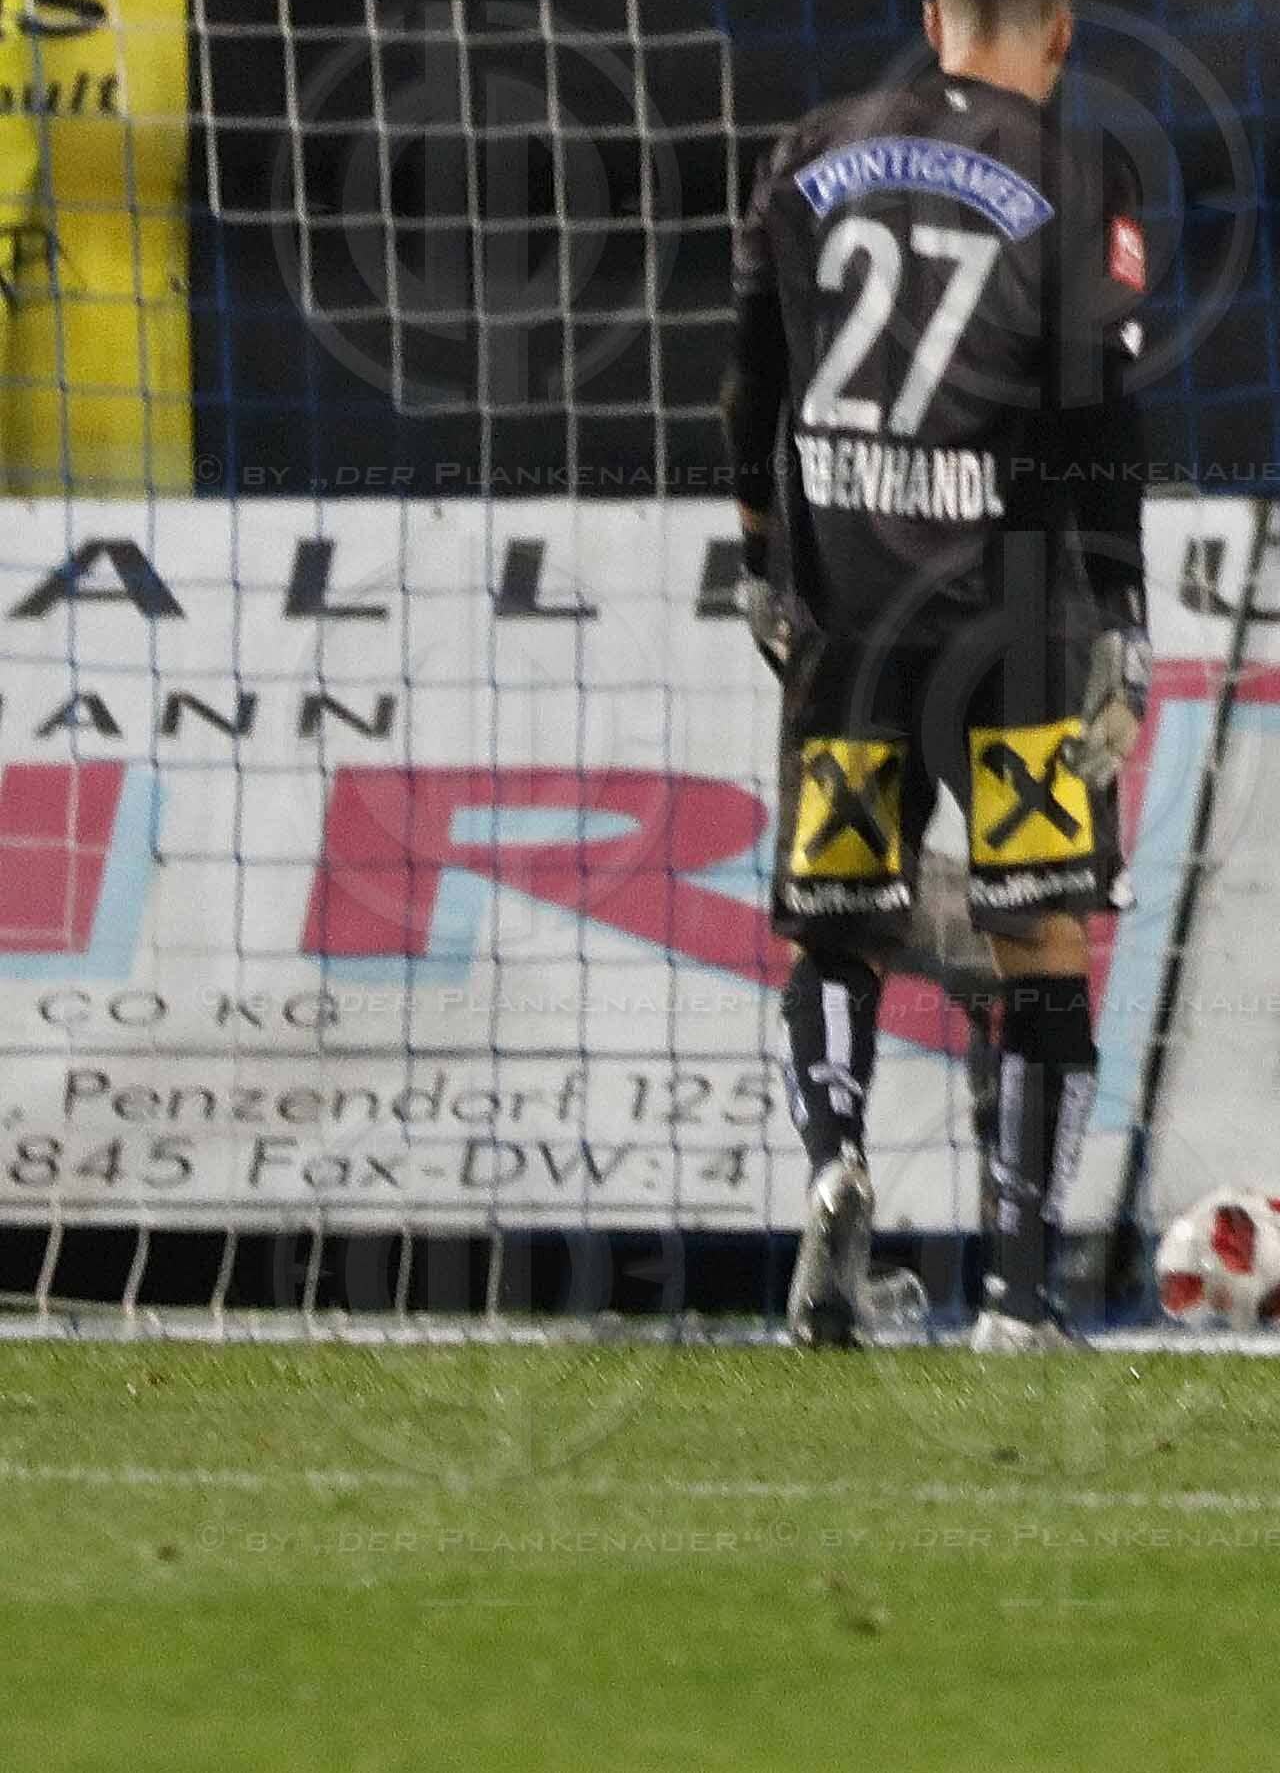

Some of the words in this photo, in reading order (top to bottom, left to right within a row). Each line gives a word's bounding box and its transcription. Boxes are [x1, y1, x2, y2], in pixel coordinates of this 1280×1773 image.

[802, 218, 1000, 436] 27
[0, 691, 397, 740] ANN
[37, 990, 168, 1028] CO
[65, 1067, 588, 1124] Penzendorf
[628, 1073, 777, 1126] 125
[8, 1135, 194, 1189] 845
